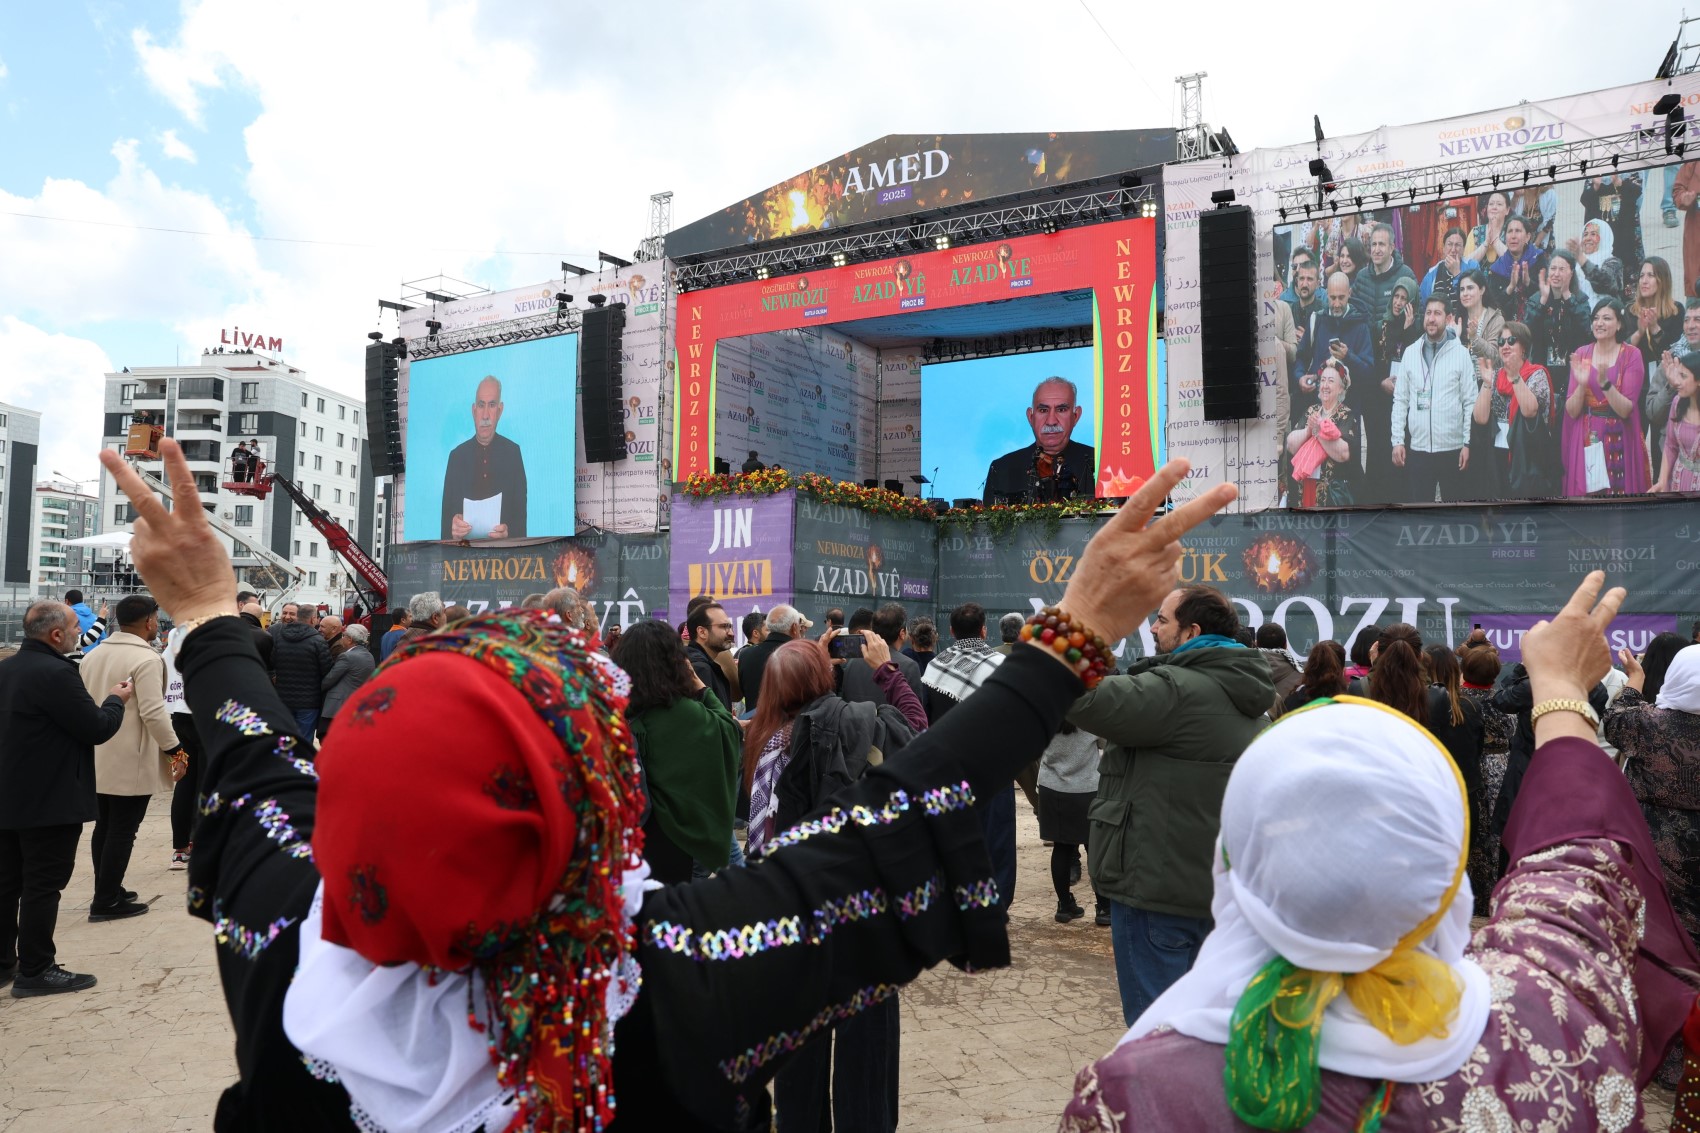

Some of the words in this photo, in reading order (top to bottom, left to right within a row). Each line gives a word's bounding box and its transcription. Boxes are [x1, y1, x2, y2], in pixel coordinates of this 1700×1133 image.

[1439, 123, 1565, 158] NEWROZU
[842, 148, 950, 197] AMED
[882, 189, 906, 202] 2025
[952, 249, 994, 265] NEWROZA
[854, 265, 893, 280] NEWROZA
[761, 282, 796, 295] ÖZGÜRLÜK
[761, 288, 828, 312] NEWROZU
[514, 297, 558, 314] NEWROZ
[1113, 238, 1136, 373] NEWROZ
[220, 326, 282, 352] LİVAM
[688, 306, 703, 416] NEWROZ
[1120, 384, 1131, 456] 2025
[708, 508, 753, 554] JIN
[816, 540, 864, 560] NEWROZA
[443, 557, 546, 581] NEWROZA
[698, 562, 763, 596] JIYAN
[903, 582, 920, 594] PİROZ
[921, 584, 928, 596] BE
